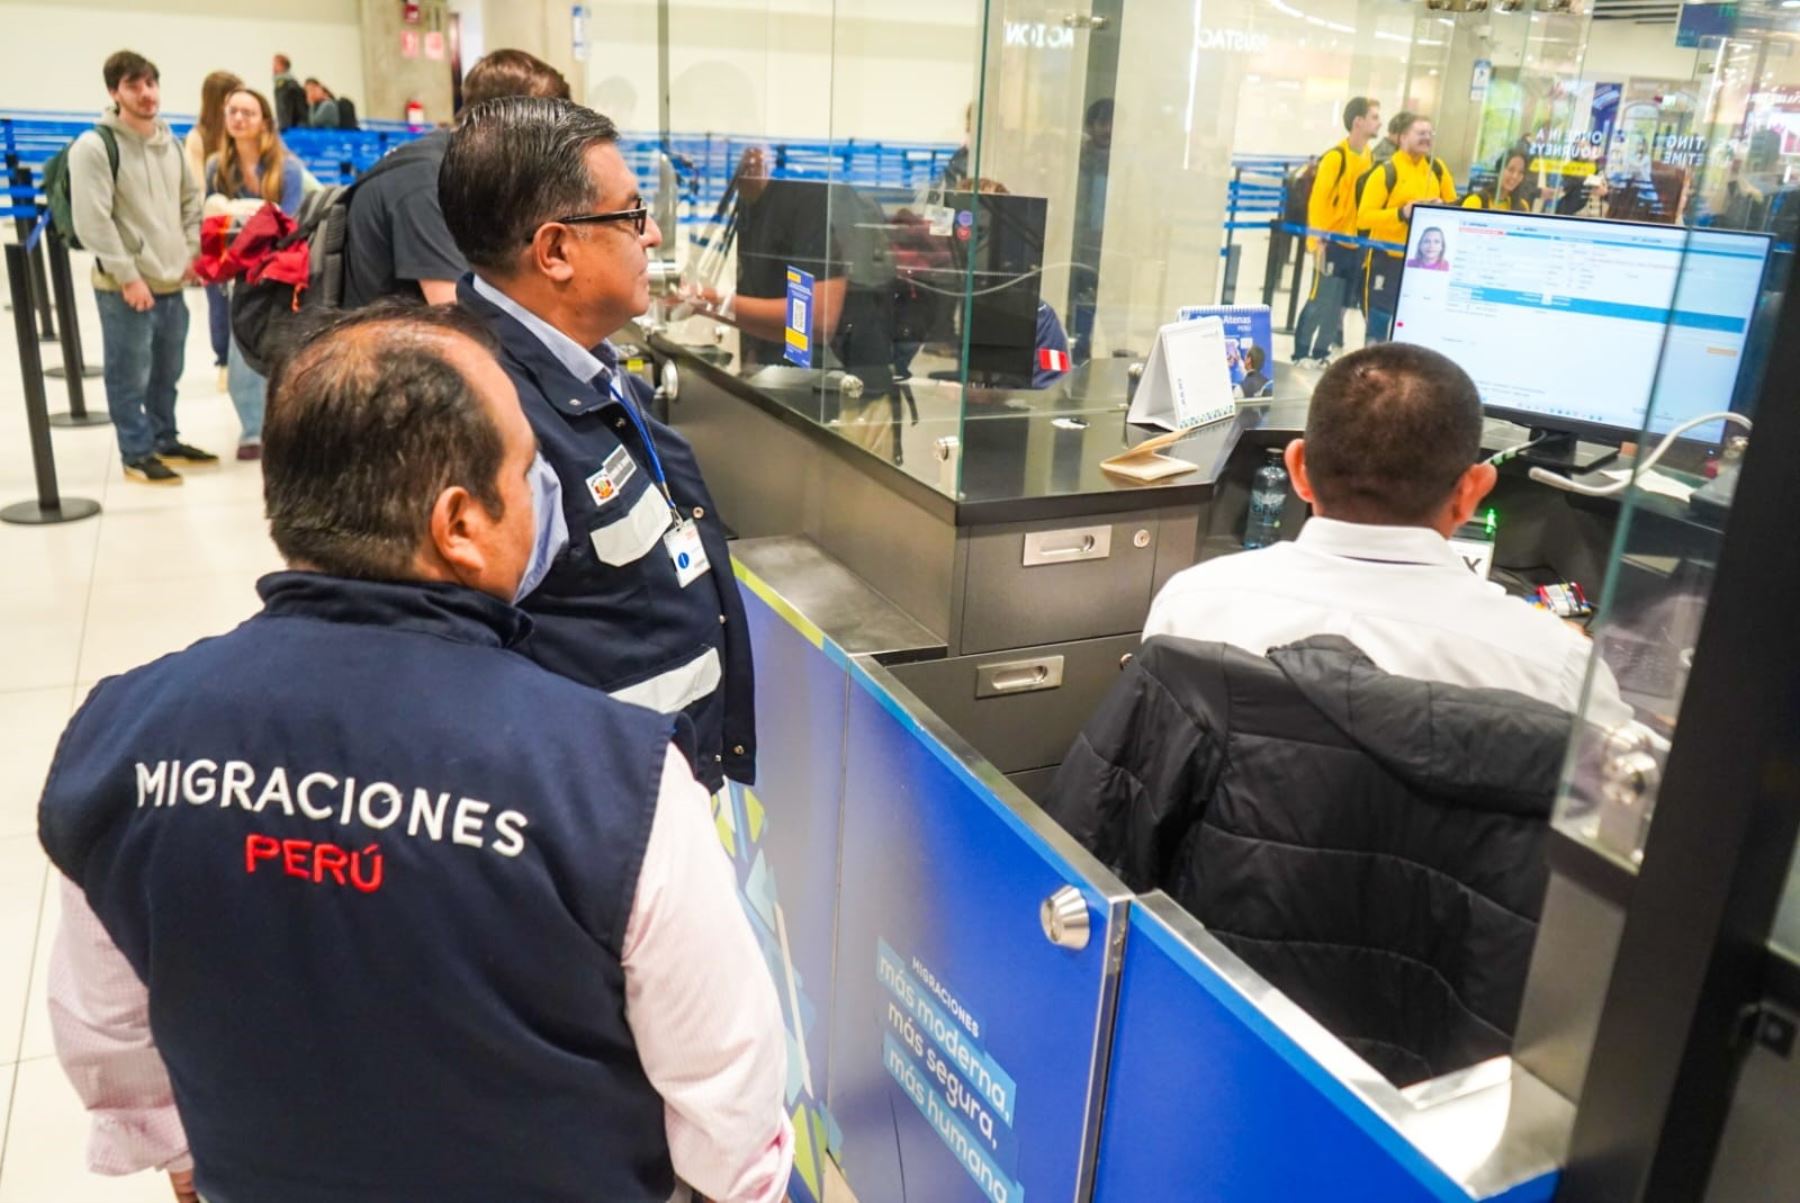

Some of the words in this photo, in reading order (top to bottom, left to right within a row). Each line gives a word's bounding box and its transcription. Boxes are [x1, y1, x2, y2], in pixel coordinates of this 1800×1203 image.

[134, 759, 529, 858] MIGRACIONES
[244, 833, 385, 894] PERÚ
[880, 956, 915, 1009] más
[917, 998, 1011, 1121] moderna,
[912, 956, 980, 1039] MIGRACIONES
[888, 1001, 925, 1058] más
[927, 1048, 998, 1150] segura,
[889, 1047, 925, 1105] más
[927, 1090, 1008, 1203] humana
